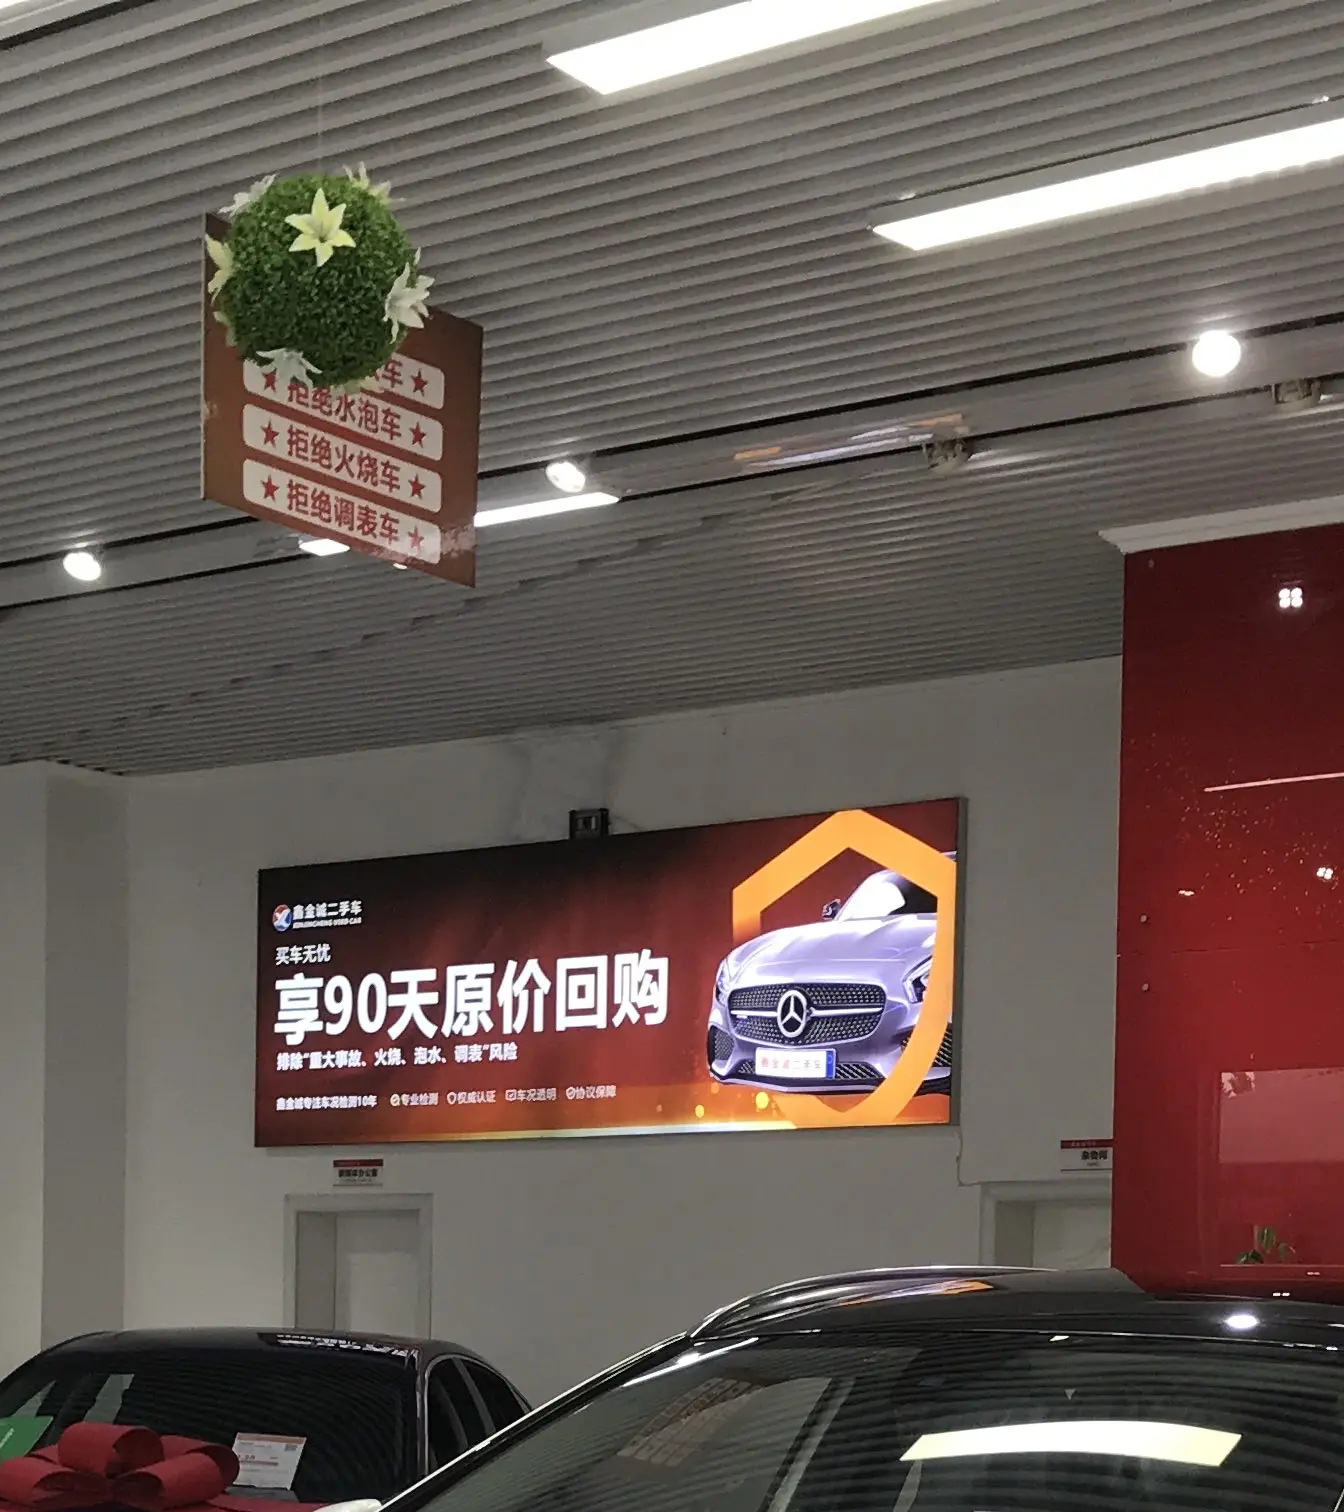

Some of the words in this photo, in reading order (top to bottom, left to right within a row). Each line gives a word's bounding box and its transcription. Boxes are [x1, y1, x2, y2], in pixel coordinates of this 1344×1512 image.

[287, 383, 403, 441] 拒绝水泡车
[287, 424, 401, 493] 拒绝火烧车
[287, 479, 400, 545] 拒绝调表车
[275, 943, 331, 966] 买车无忧
[273, 948, 669, 1046] 享90天原价回购
[576, 1085, 617, 1100] 协议保障
